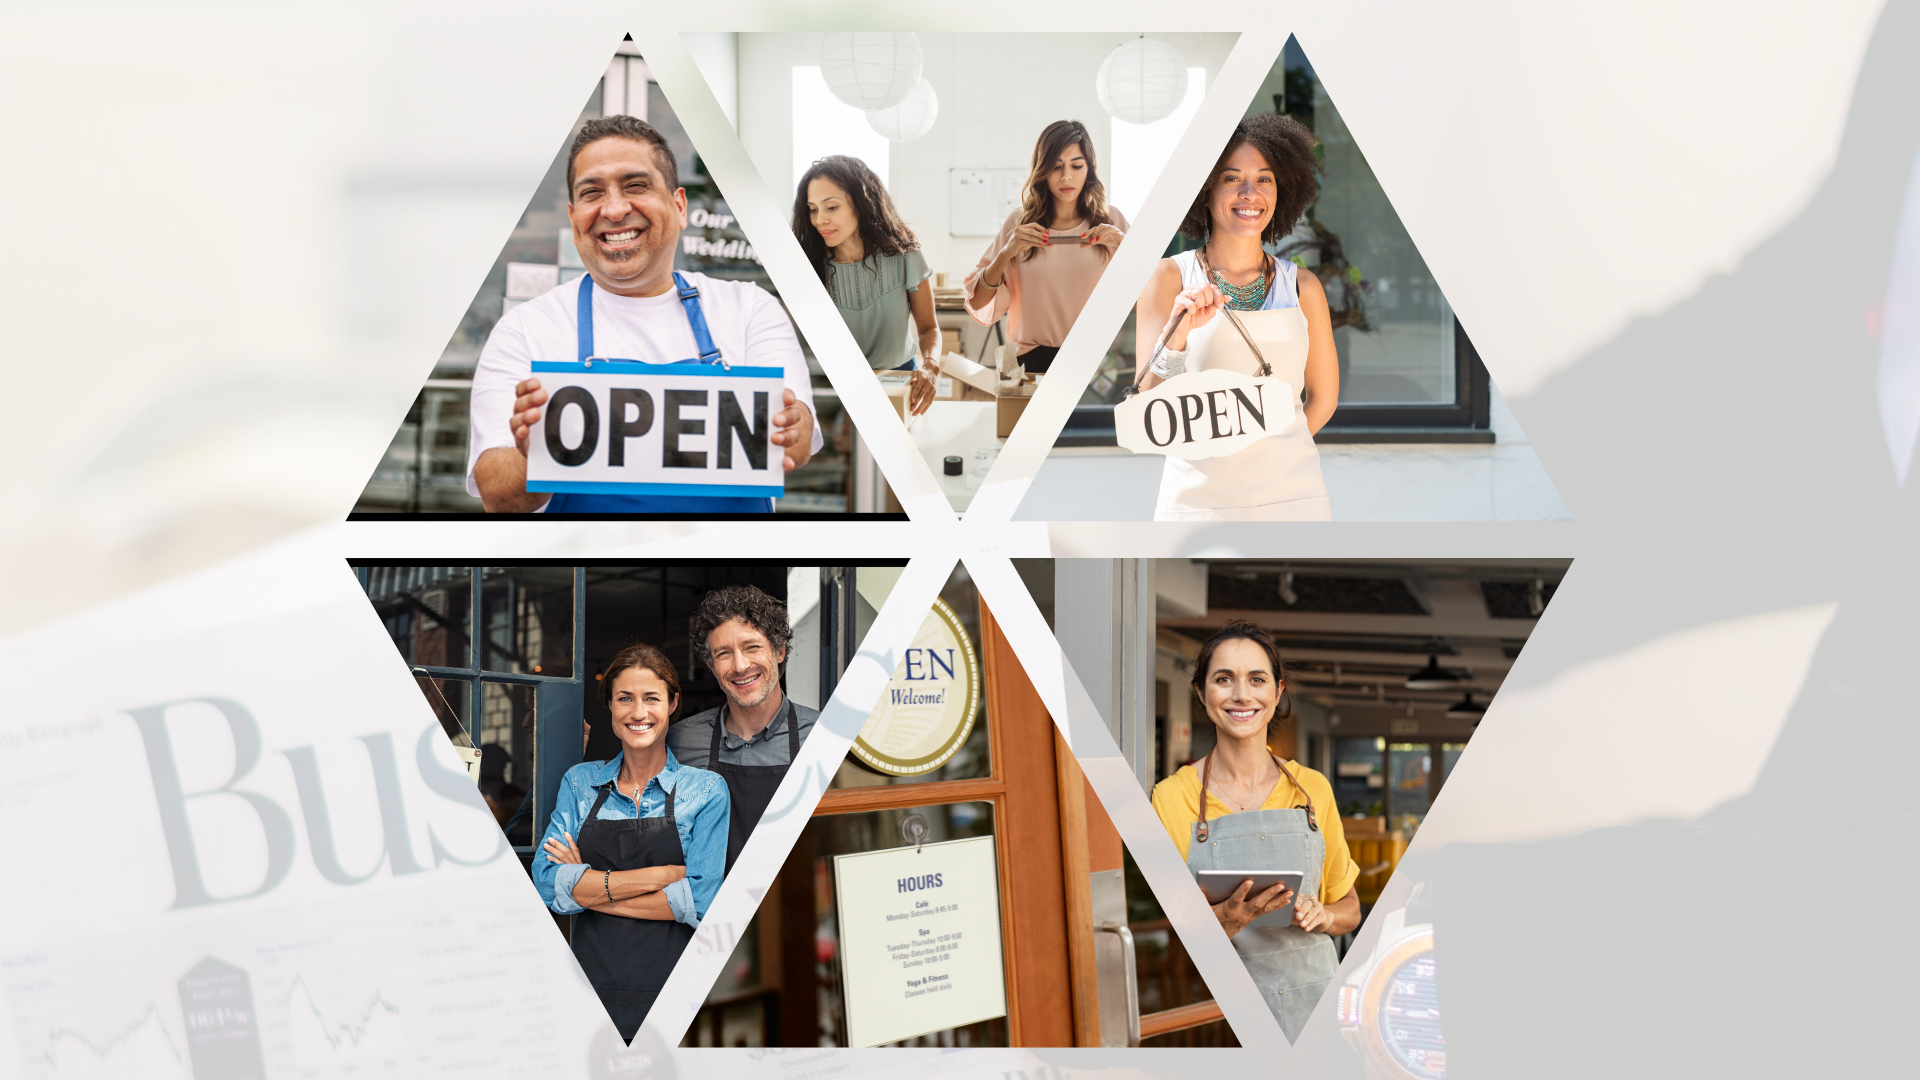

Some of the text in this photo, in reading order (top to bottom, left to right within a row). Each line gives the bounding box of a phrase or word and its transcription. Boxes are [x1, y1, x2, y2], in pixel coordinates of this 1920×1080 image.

[690, 208, 734, 230] Our
[1143, 383, 1267, 447] OPEN
[544, 385, 769, 470] OPEN
[889, 648, 955, 681] EN
[890, 688, 945, 705] Welcome!
[897, 872, 943, 893] HOURS
[886, 903, 958, 922] Monday-Saturday 8:45-5:00
[915, 900, 929, 909] Café
[918, 928, 930, 937] Spa
[886, 937, 936, 953] Tuesday-Thursday
[892, 947, 935, 961] Friday-Saturday
[902, 959, 923, 969] Sunday
[906, 978, 921, 988] Yoga
[928, 973, 949, 983] Fitness
[904, 982, 952, 999] Classes held daily
[779, 1048, 841, 1069] (November)
